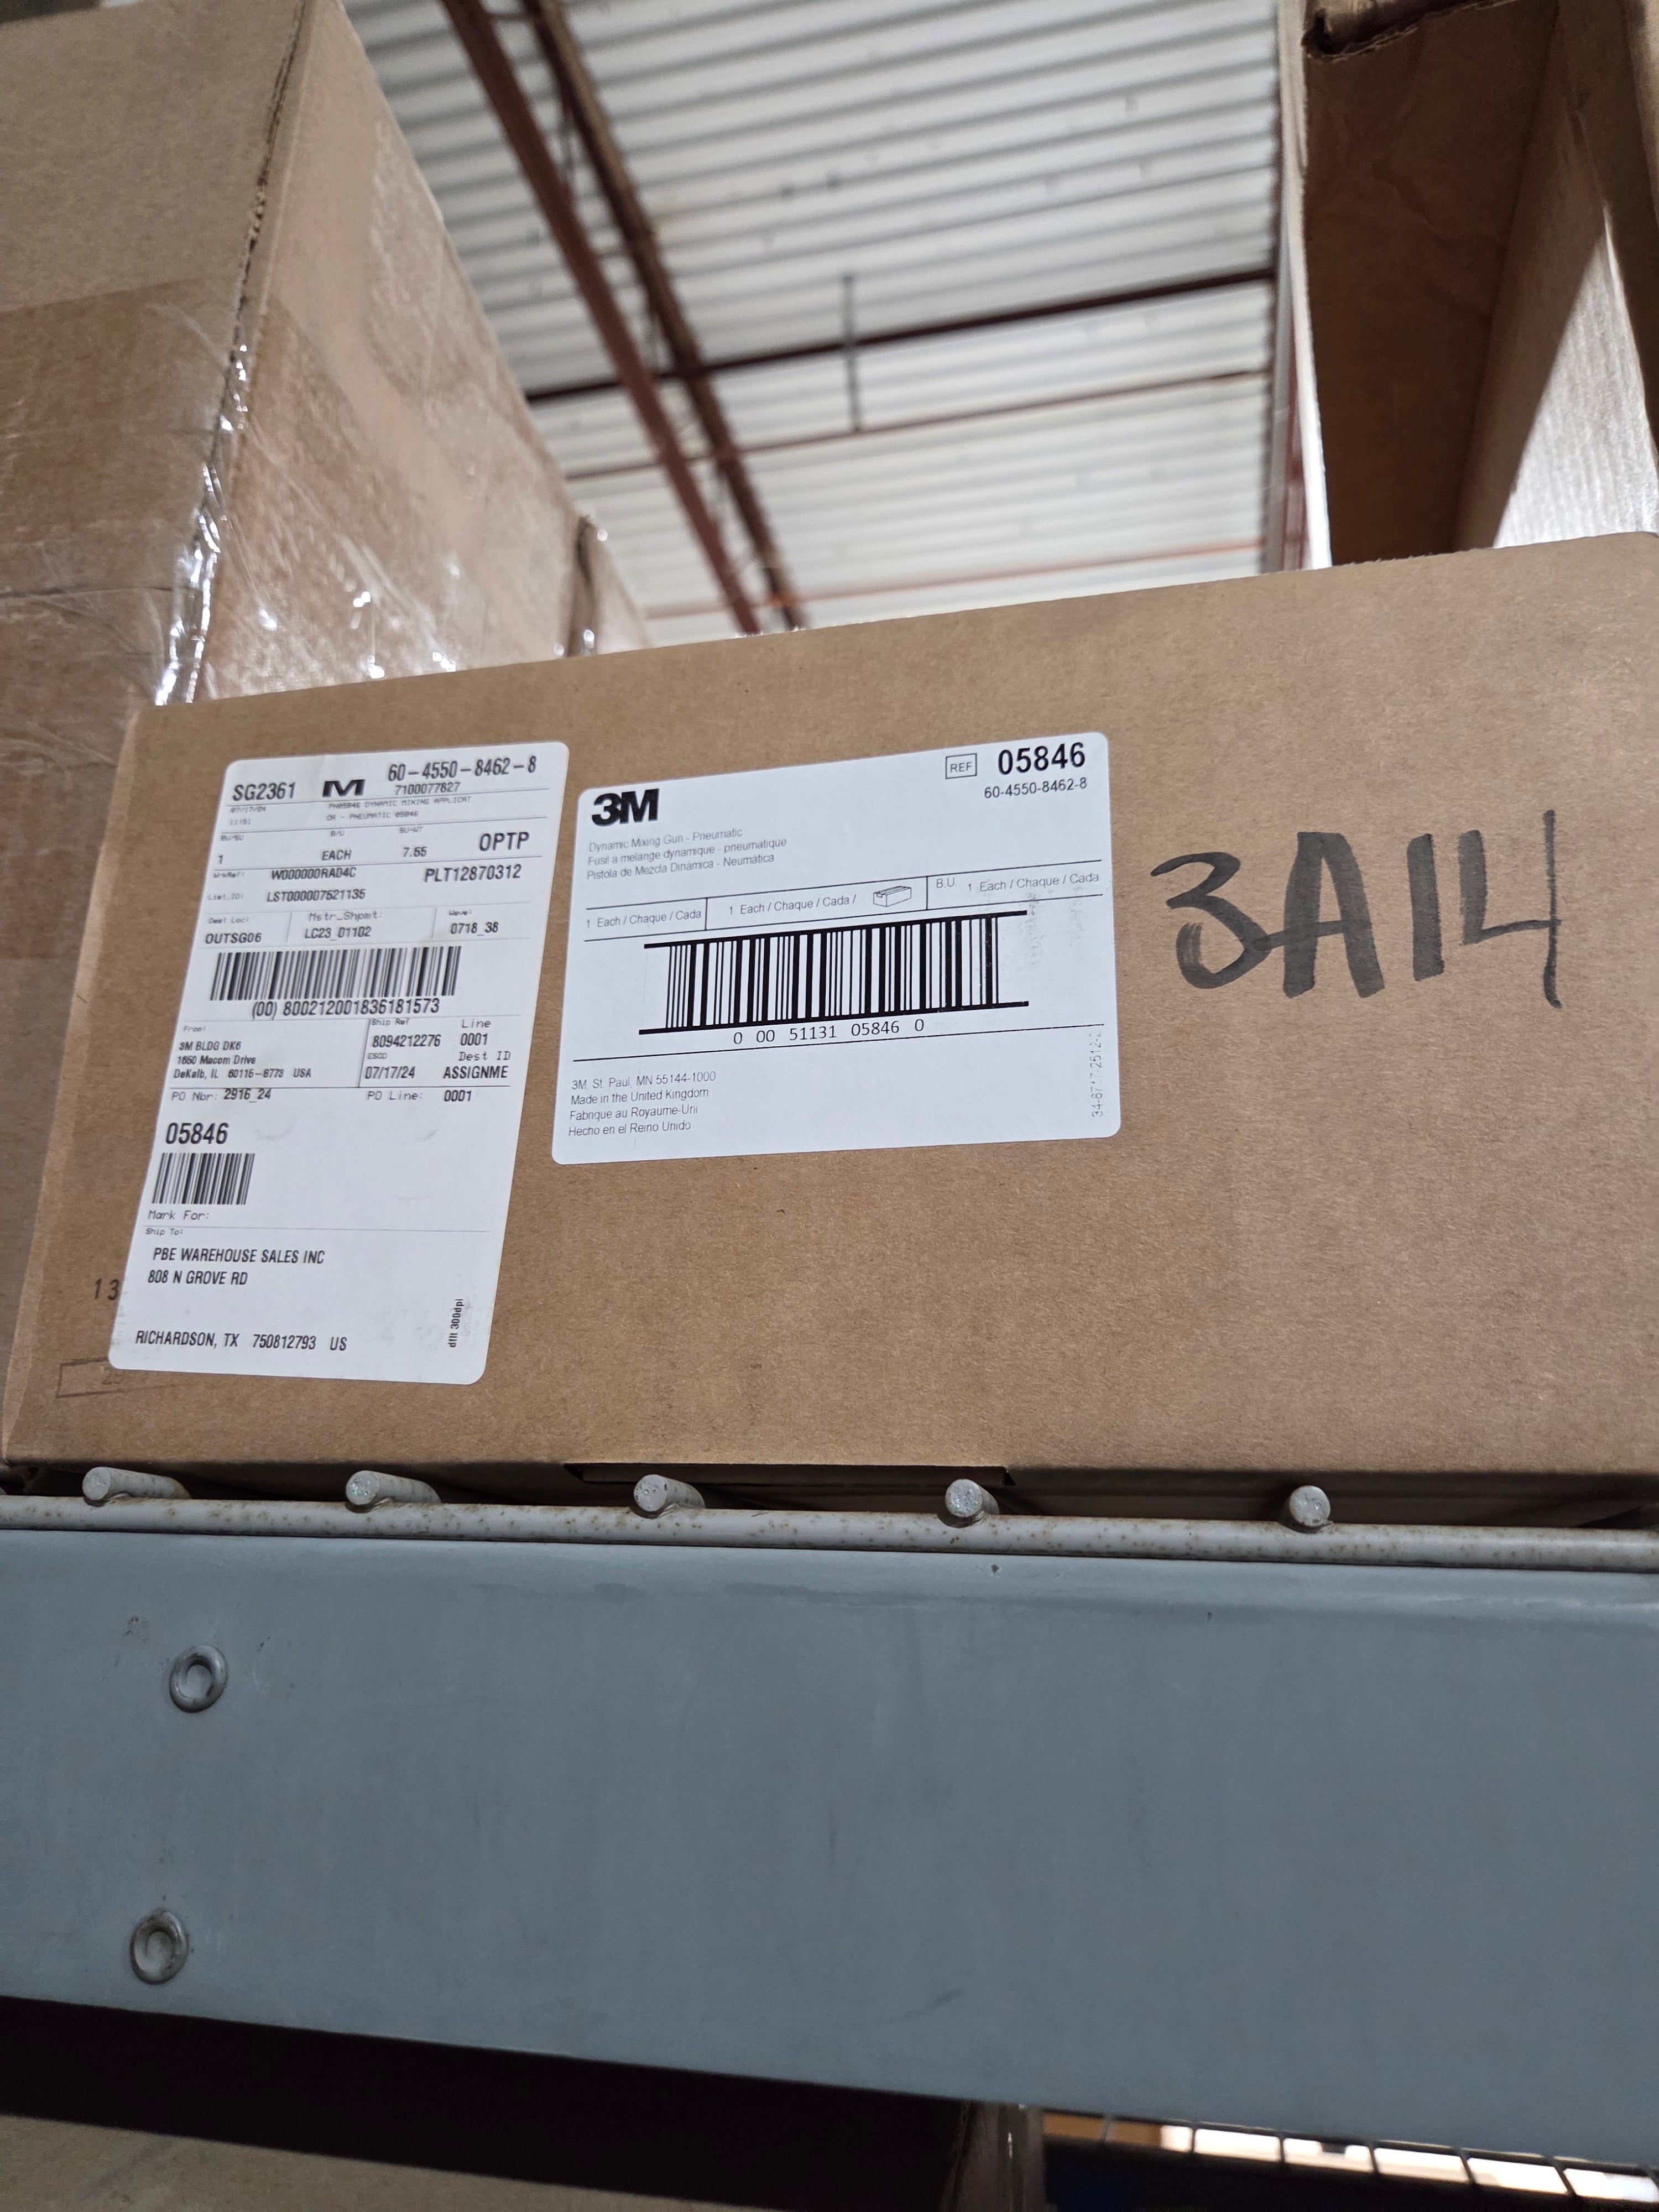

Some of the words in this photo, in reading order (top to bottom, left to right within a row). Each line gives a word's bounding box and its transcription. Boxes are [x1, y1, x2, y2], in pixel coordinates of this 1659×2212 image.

[998, 742, 1086, 775] 05846
[950, 761, 972, 773] REF
[232, 782, 296, 801] SG2361
[395, 781, 461, 795] 7100077827
[984, 777, 1087, 799] 60-4550-8462-8
[364, 800, 398, 808] DYNAMIC
[434, 796, 472, 804] APPLICAT
[592, 788, 660, 827] 3M
[349, 812, 391, 820] PNEUMATIC
[479, 831, 530, 852] OPTP
[589, 841, 629, 854] Dynamic
[632, 837, 660, 848] Mixing
[664, 834, 683, 844] Gun
[693, 828, 743, 841] Pneumatic
[322, 849, 352, 860] EACH
[403, 846, 427, 857] 7.55
[664, 846, 715, 860] dynamique
[724, 838, 787, 854] pneumatique
[218, 855, 223, 864] 1
[424, 864, 522, 883] PLT12870312
[587, 869, 617, 880] Pistola
[620, 868, 632, 877] de
[635, 864, 667, 875] Mezcla
[980, 880, 1006, 891] Each
[1016, 877, 1059, 888] Chaque
[1070, 873, 1099, 884] Cada
[740, 903, 765, 914] Each
[774, 900, 813, 911] Chaque
[823, 895, 849, 906] Cada
[1150, 810, 1562, 1008] 3A114
[597, 916, 620, 927] Each
[629, 913, 667, 926] Chaque
[676, 910, 701, 920] Cada
[450, 921, 499, 936] 0718_38
[205, 932, 262, 945] OUTSG06
[252, 1001, 278, 1021] (00)
[283, 998, 440, 1016] 800212001836181573
[461, 1019, 491, 1028] Line
[734, 1032, 743, 1044] 0
[756, 1030, 775, 1043] 00
[789, 1025, 837, 1041] 51131
[851, 1021, 899, 1036] 05846
[915, 1019, 924, 1032] 0
[196, 1041, 220, 1051] BLDG
[223, 1041, 242, 1050] DK6
[372, 1034, 441, 1047] 8094212276
[460, 1033, 488, 1046] 0001
[200, 1056, 231, 1065] Macom
[233, 1055, 256, 1065] Drive
[458, 1051, 488, 1061] Dest
[496, 1051, 511, 1060] ID
[293, 1068, 311, 1078] USA
[365, 1066, 415, 1079] 07/17/24
[443, 1066, 509, 1078] ASSIGNME
[637, 1075, 653, 1086] MN
[656, 1071, 716, 1084] 55144-1000
[224, 1088, 272, 1103] 2916_24
[389, 1091, 422, 1100] Line:
[444, 1090, 472, 1102] 0001
[571, 1094, 598, 1105] Made
[601, 1093, 609, 1103] in
[612, 1093, 628, 1103] the
[631, 1090, 662, 1102] United
[666, 1088, 709, 1101] Kingdom
[615, 1110, 628, 1118] au
[631, 1104, 698, 1119] Royaume-Uni
[166, 1122, 229, 1145] 05846
[568, 1126, 600, 1136] Hecho
[603, 1126, 615, 1135] en
[618, 1124, 626, 1134] el
[630, 1123, 659, 1133] Reino
[662, 1120, 691, 1131] Unido
[148, 1210, 175, 1220] Mark
[183, 1210, 209, 1220] For:
[153, 1248, 177, 1261] PBE
[181, 1248, 257, 1262] WAREHOUSE
[261, 1250, 299, 1264] SALES
[304, 1251, 325, 1264] INC
[148, 1270, 169, 1284] 808
[173, 1271, 182, 1283] N
[186, 1271, 227, 1285] GROVE
[231, 1272, 248, 1285] RD
[135, 1331, 217, 1349] RICHARDSON,
[224, 1333, 240, 1347] TX
[253, 1334, 317, 1349] 750812793
[330, 1336, 347, 1351] US
